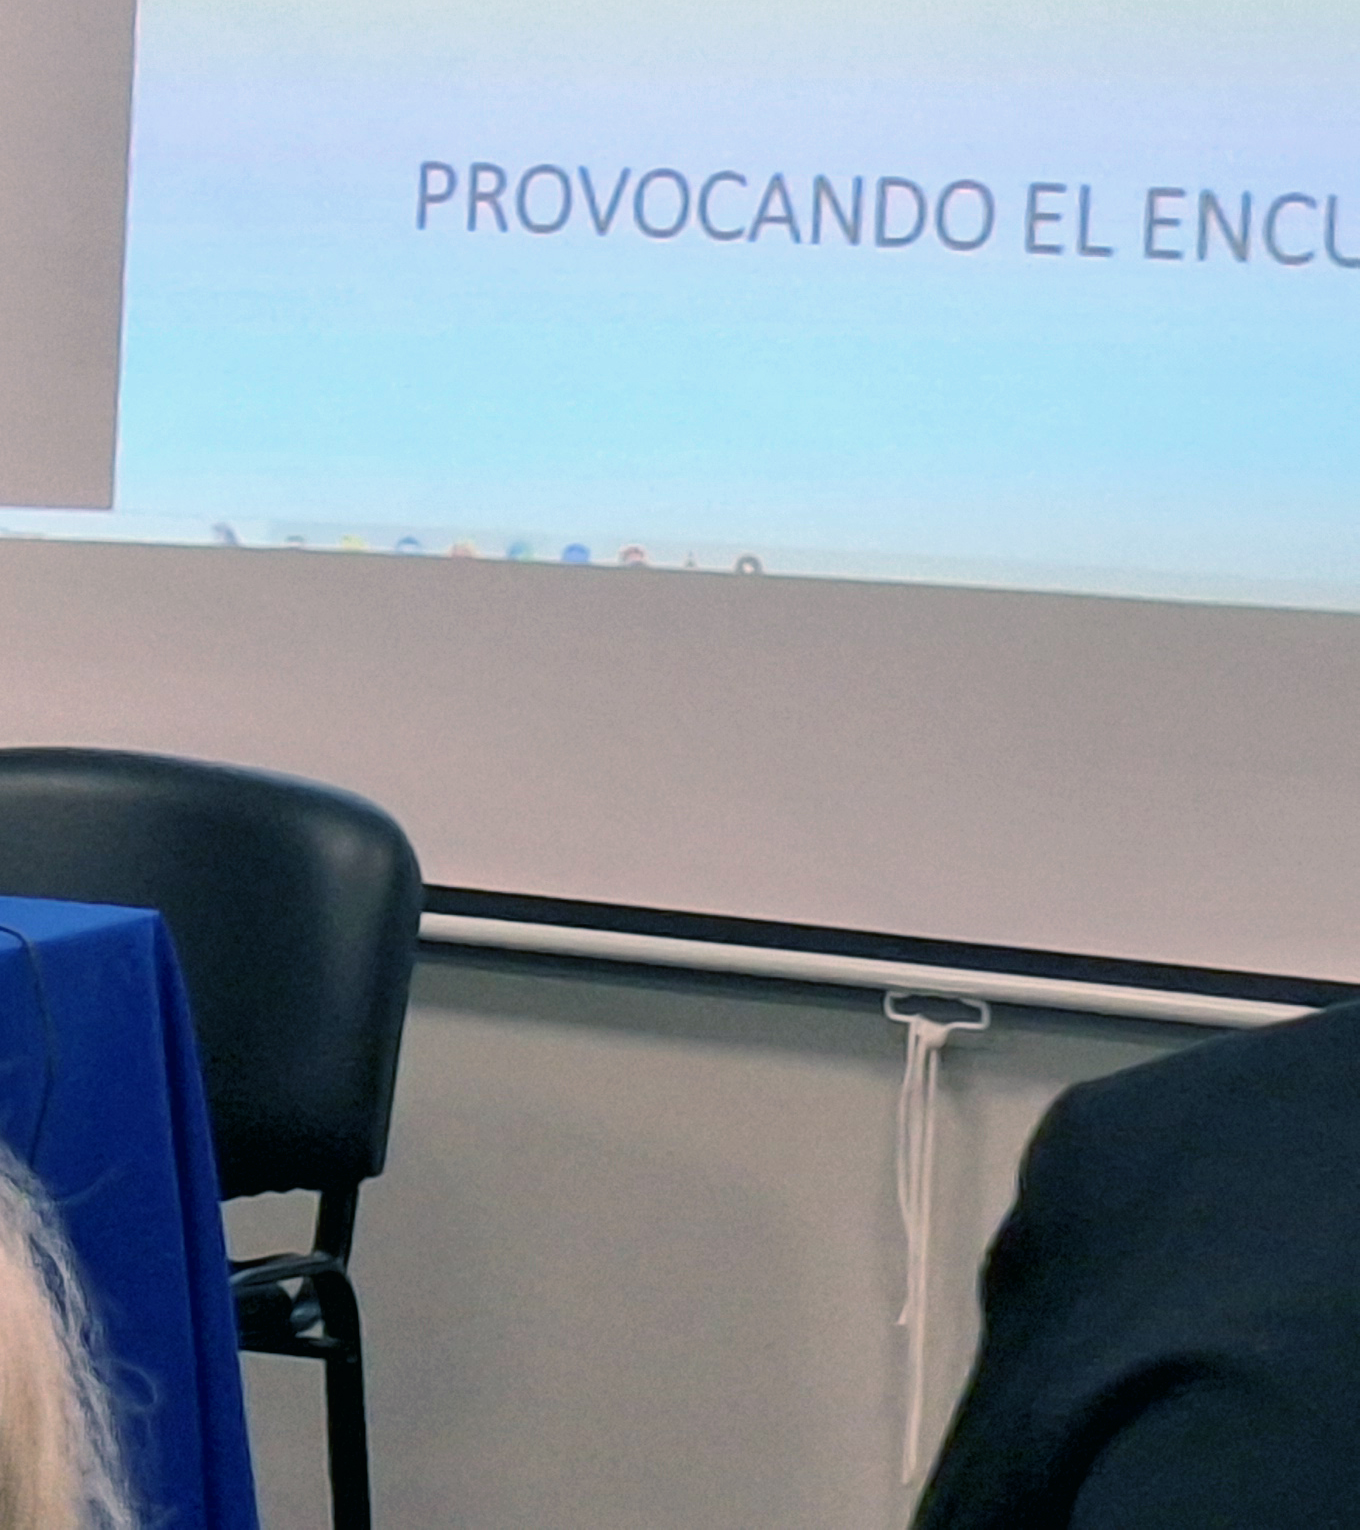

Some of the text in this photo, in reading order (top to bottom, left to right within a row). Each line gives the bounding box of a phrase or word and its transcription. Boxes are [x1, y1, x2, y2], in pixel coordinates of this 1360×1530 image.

[416, 160, 1360, 270] PROVOCANDO EL ENCU
